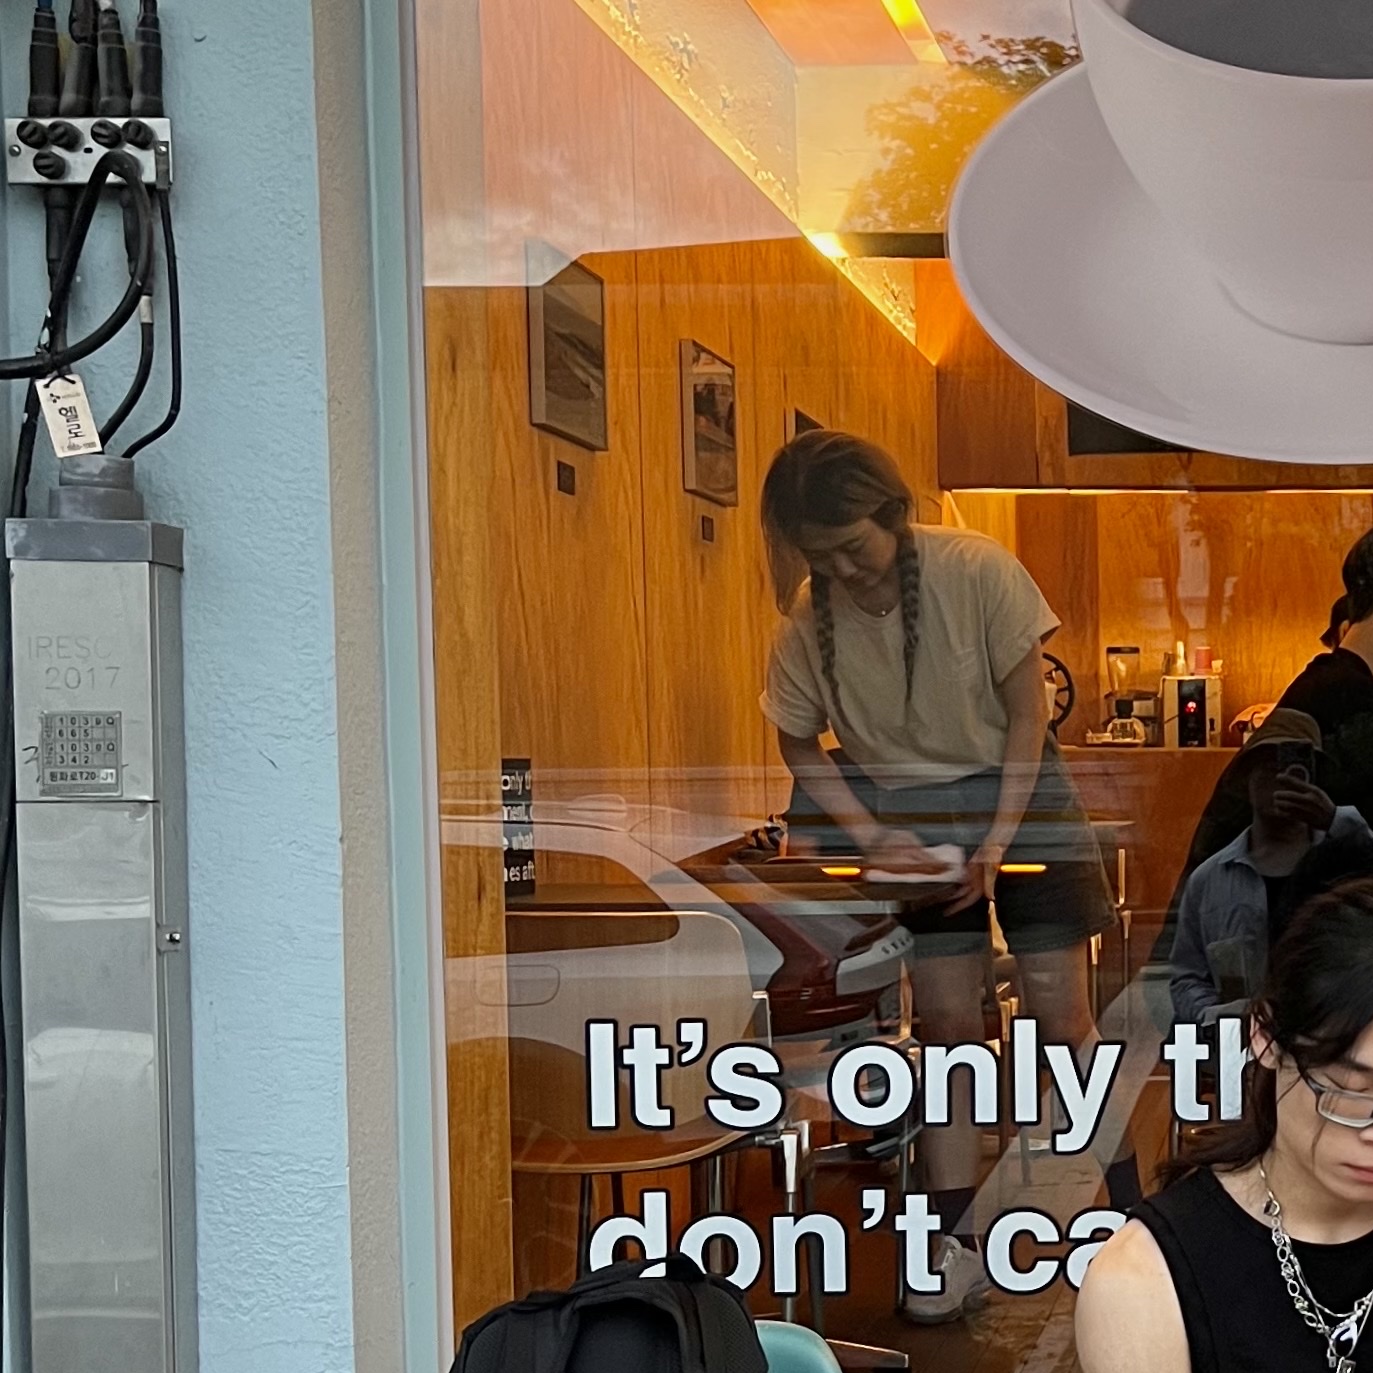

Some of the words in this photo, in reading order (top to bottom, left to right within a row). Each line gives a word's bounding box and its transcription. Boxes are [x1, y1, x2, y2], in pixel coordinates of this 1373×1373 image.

[45, 666, 120, 690] 2017
[586, 1019, 783, 1130] It's
[828, 1016, 1124, 1154] only
[588, 1187, 945, 1296] don't
